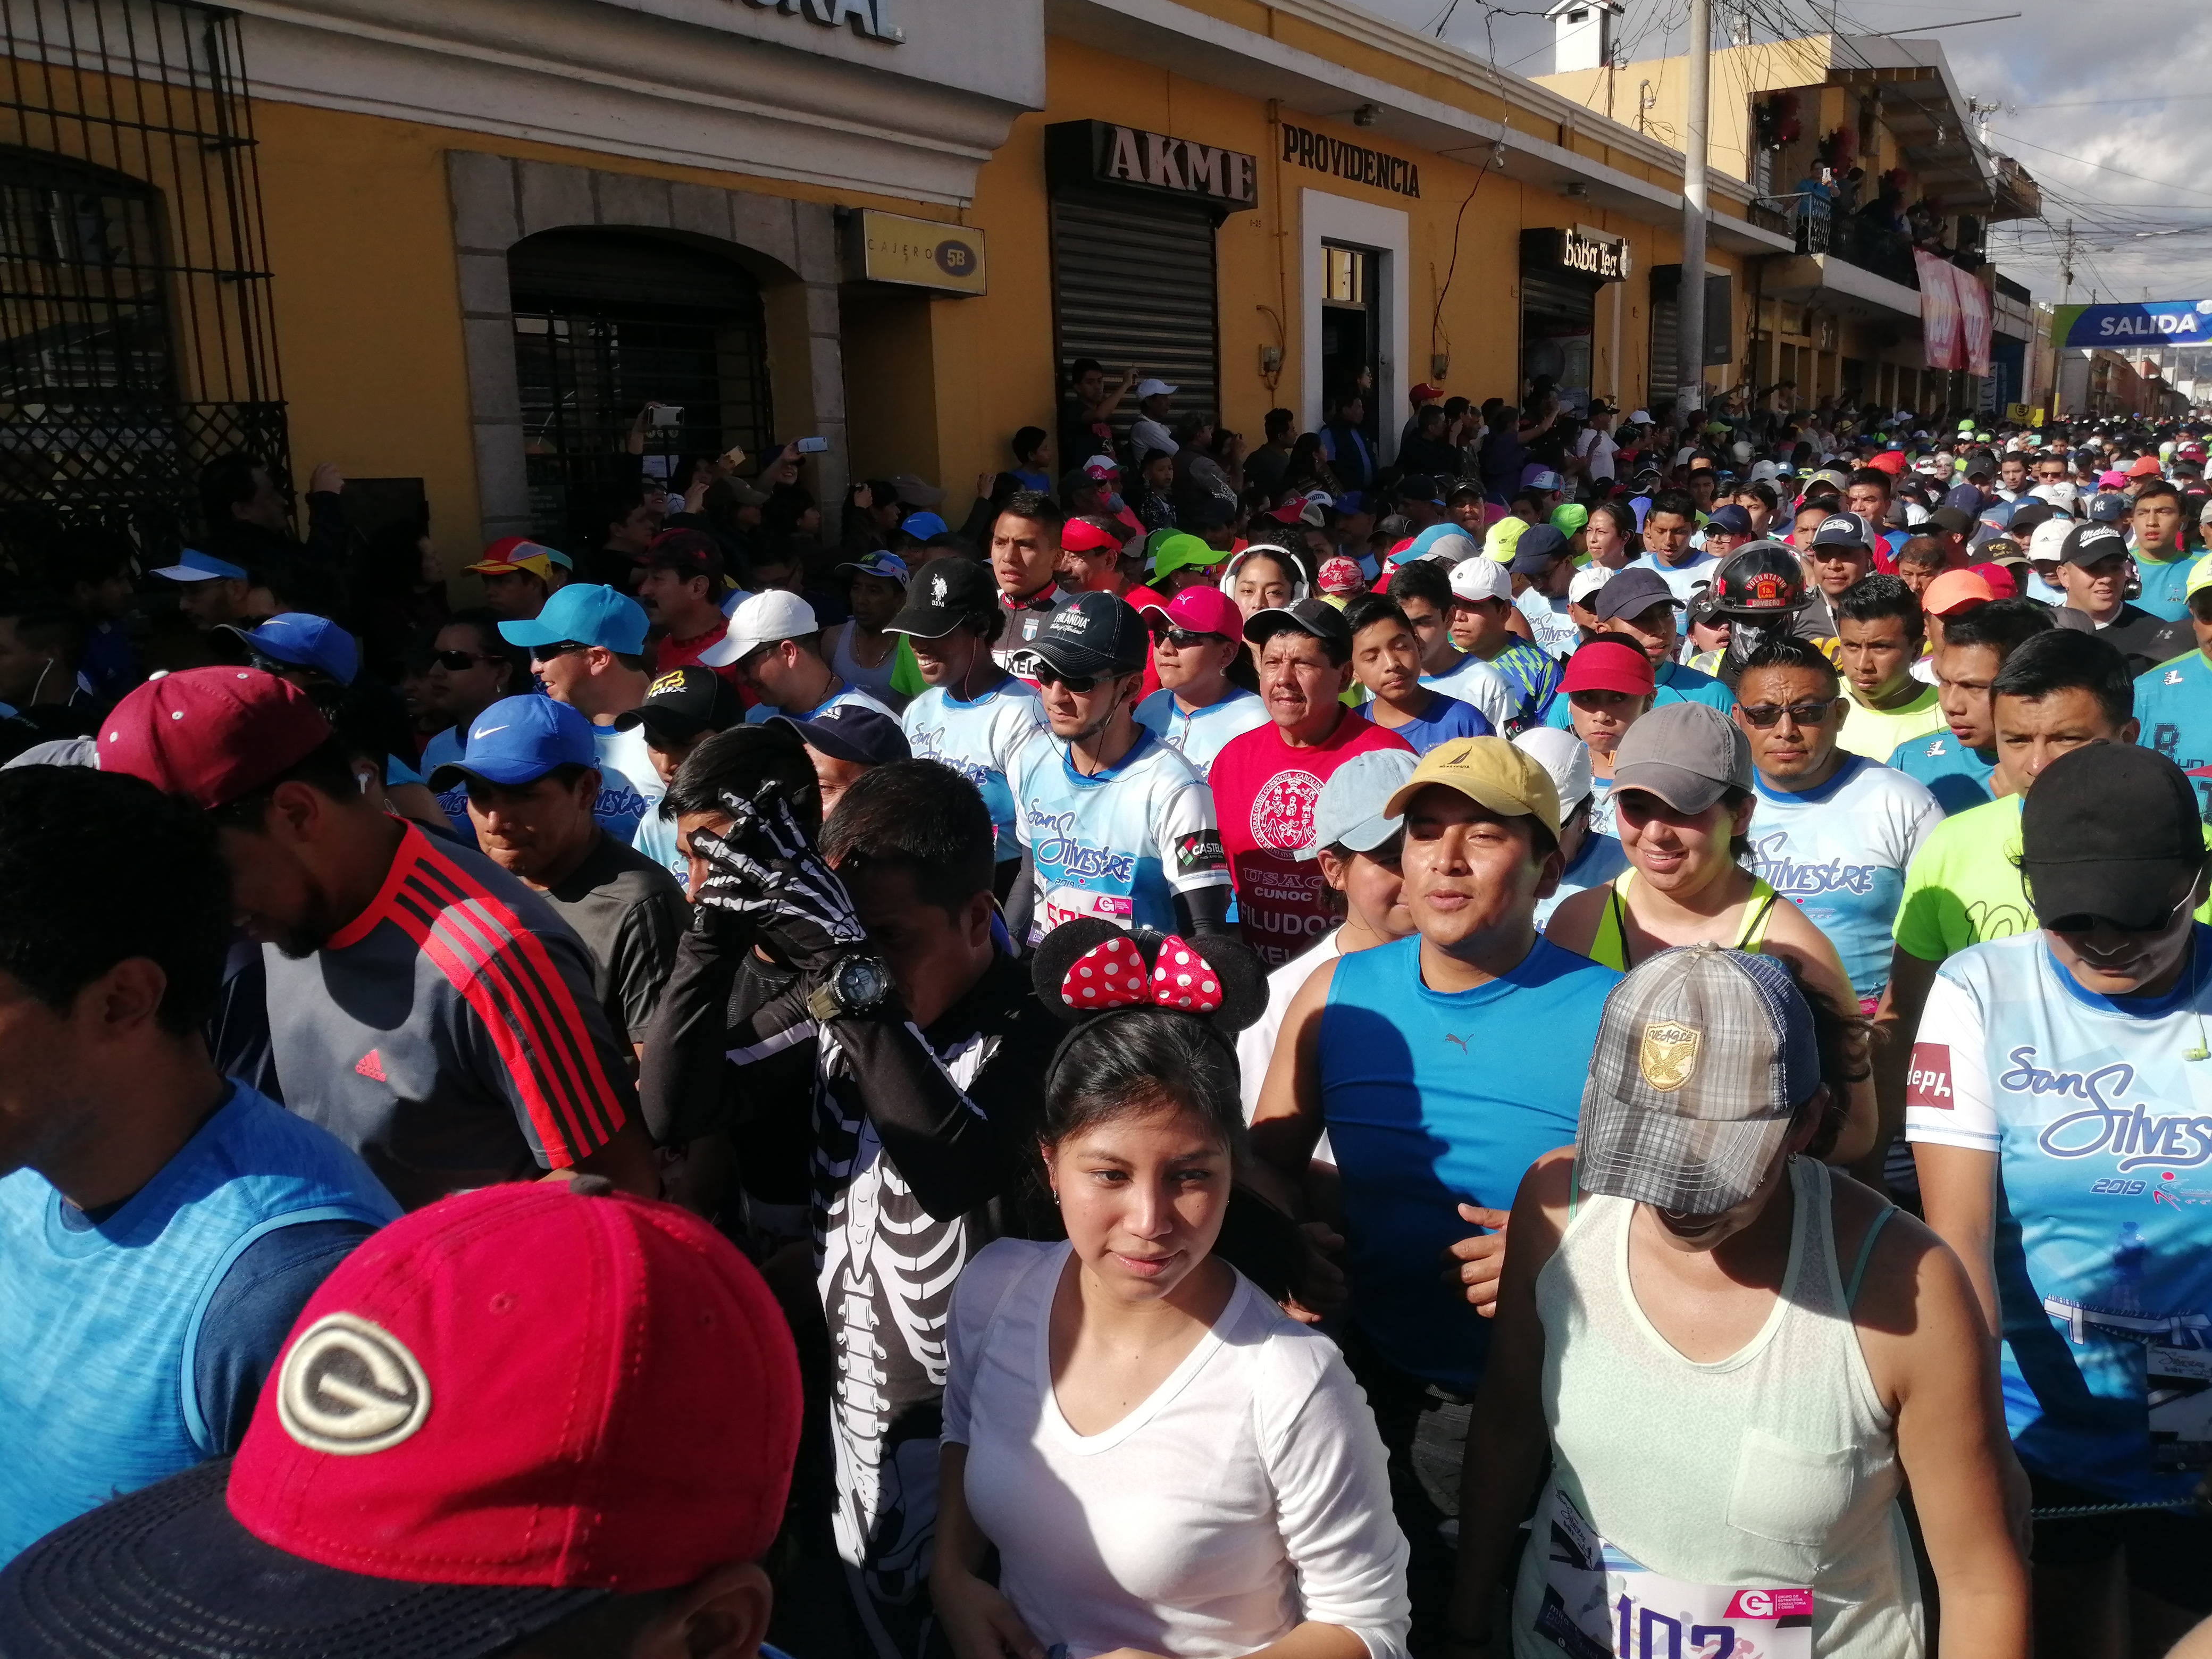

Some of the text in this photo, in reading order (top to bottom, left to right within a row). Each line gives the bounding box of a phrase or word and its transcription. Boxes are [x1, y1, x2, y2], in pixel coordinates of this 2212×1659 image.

[1109, 126, 1254, 203] AKME
[1281, 122, 1421, 199] PROVIDENCIA
[868, 239, 966, 267] CAJERO 5B
[1599, 242, 1617, 277] Tea
[2099, 314, 2198, 336] SALIDA
[1746, 573, 1787, 590] VOLUNTARIO
[1053, 613, 1087, 629] FINLANDIA
[1263, 773, 1292, 794] CONSPICUA
[1296, 773, 1323, 793] CAROLINA
[1254, 793, 1266, 814] ORBIS
[1254, 886, 1313, 902] CUNOC
[2000, 1048, 2087, 1097] San
[2088, 1177, 2147, 1196] 2019
